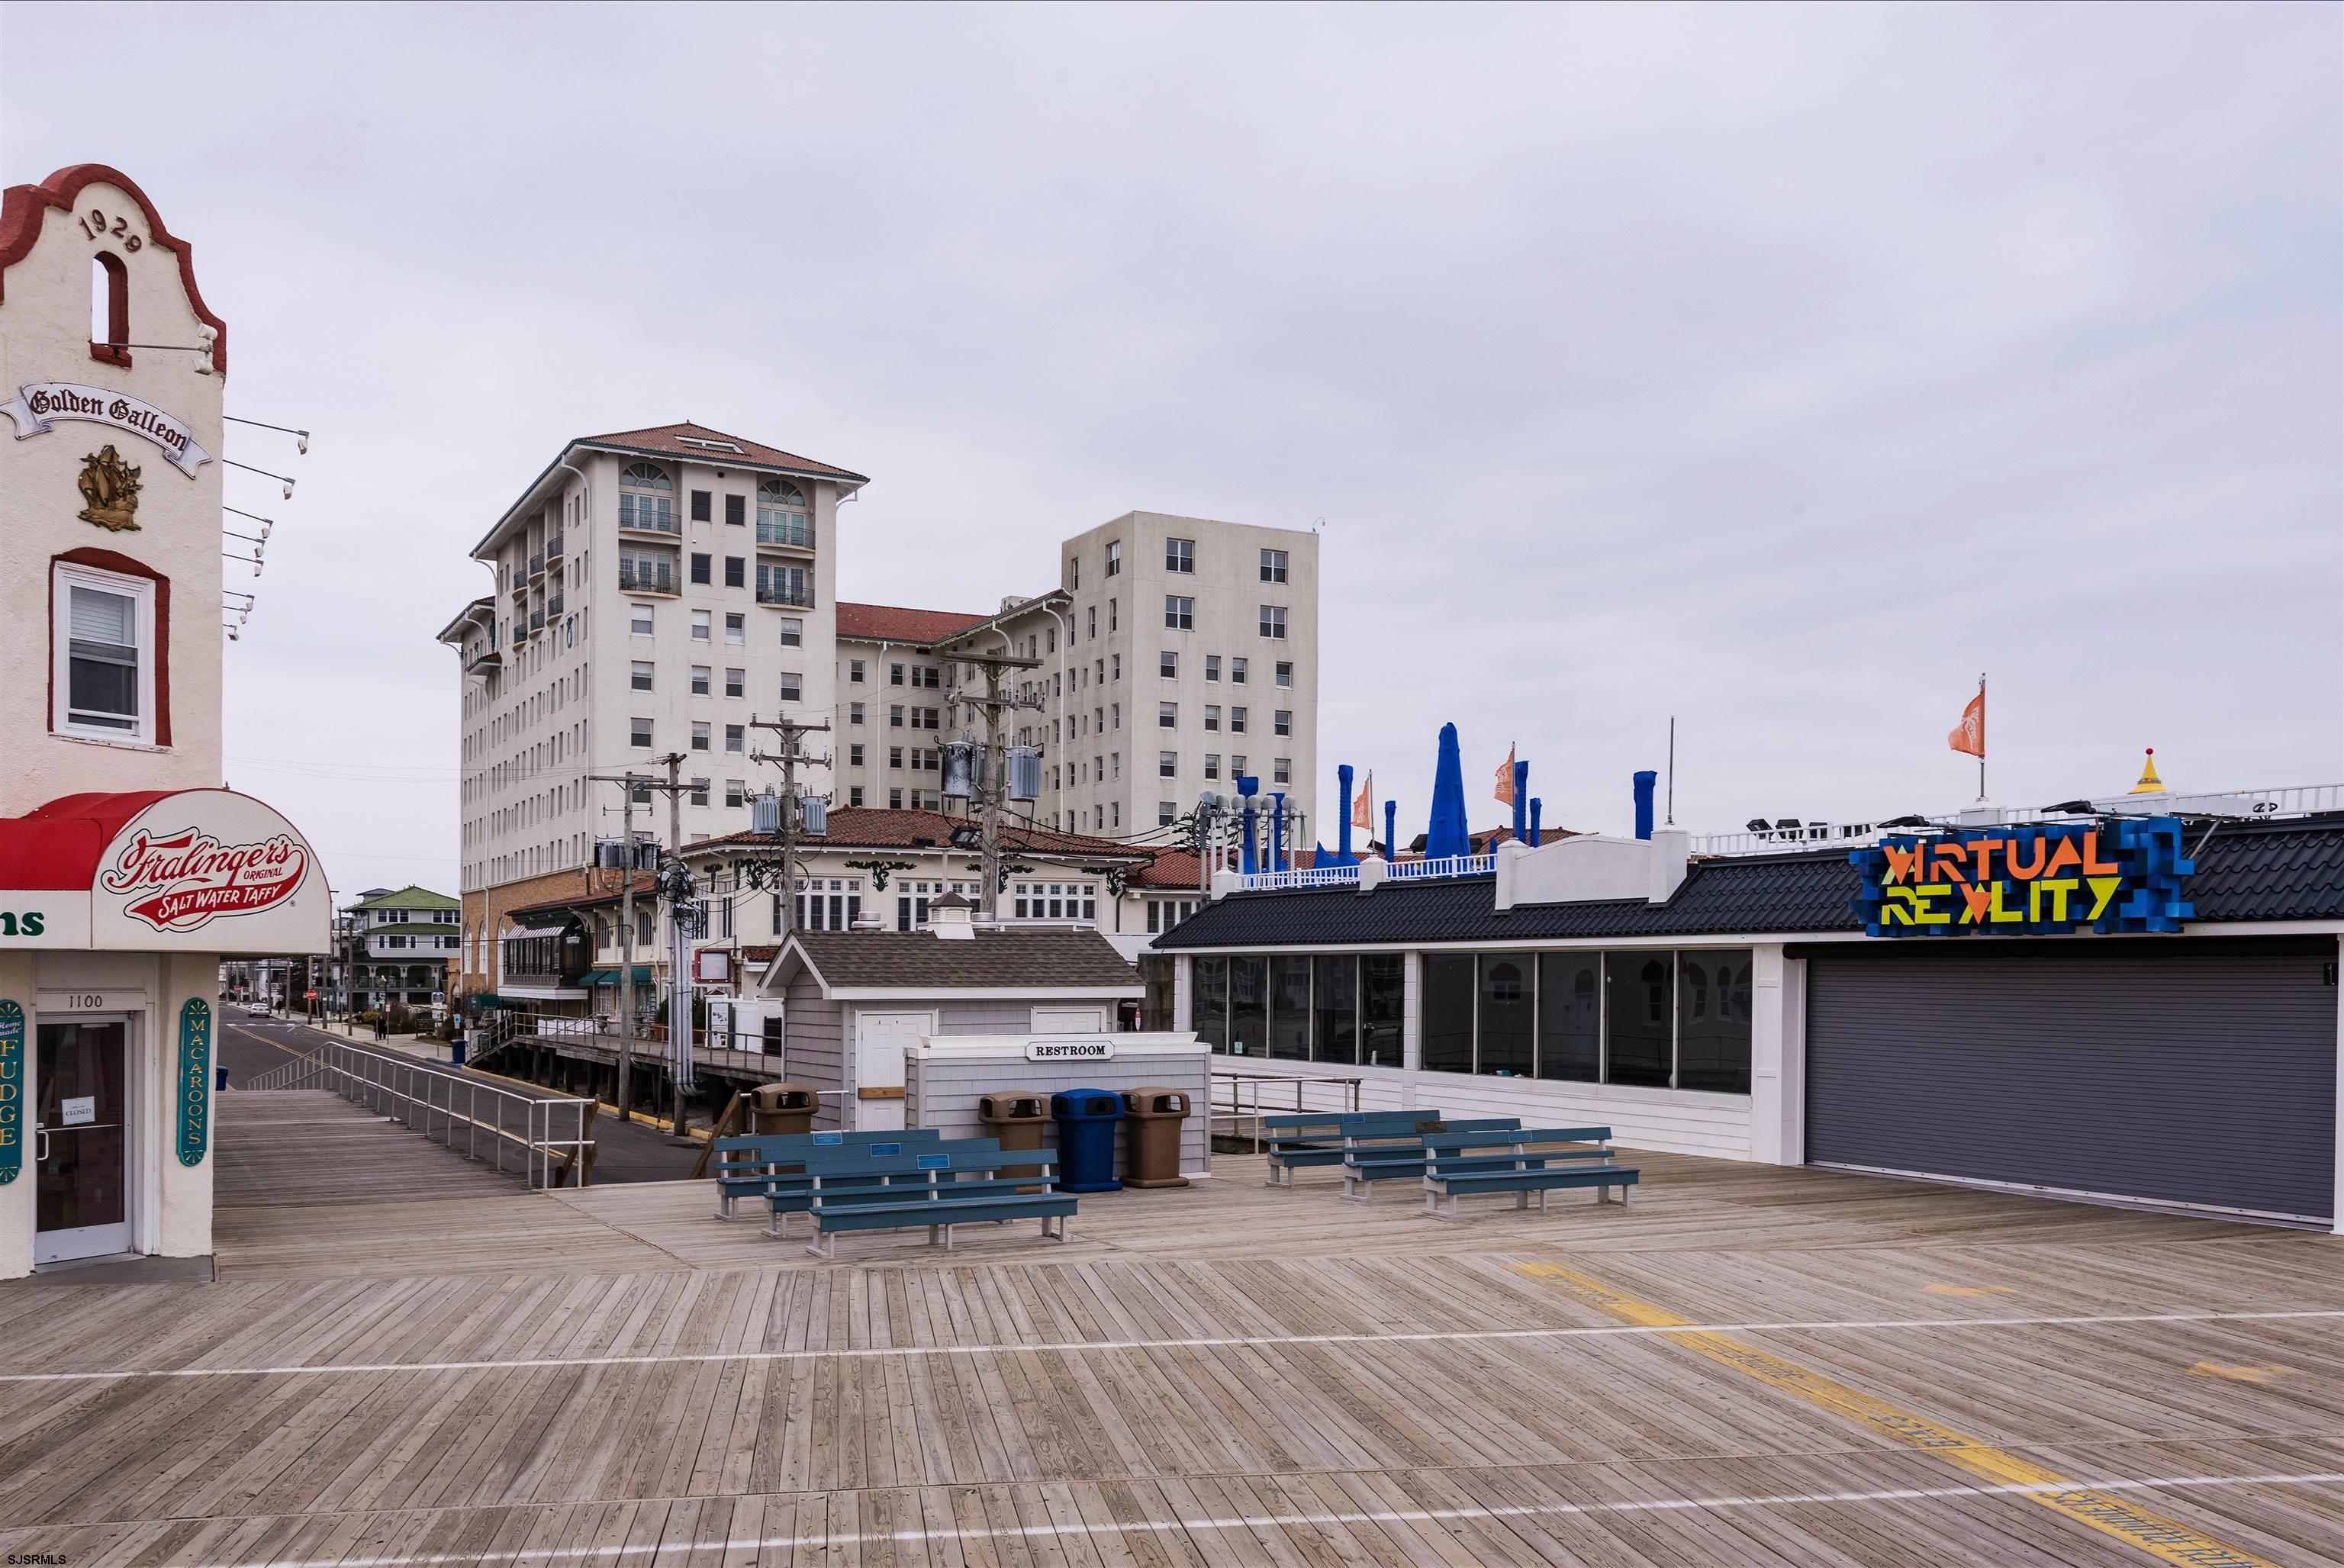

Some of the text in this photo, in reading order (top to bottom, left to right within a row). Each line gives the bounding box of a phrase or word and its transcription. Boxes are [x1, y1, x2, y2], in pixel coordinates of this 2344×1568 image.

[79, 209, 143, 253] 1929
[30, 389, 188, 452] Golden Galleon
[107, 833, 291, 889] Fralinger's
[243, 867, 283, 882] ORIGINAL
[1882, 832, 2119, 886] VIRTUAL
[158, 884, 282, 919] SALT WATER TAFFY
[1881, 877, 2123, 926] REALITY
[69, 995, 103, 1008] 1100
[1036, 1045, 1106, 1058] RESTROOM
[0, 1039, 18, 1146] FUDGE
[188, 1019, 206, 1146] MACAROONS
[66, 1108, 92, 1116] CLOSED
